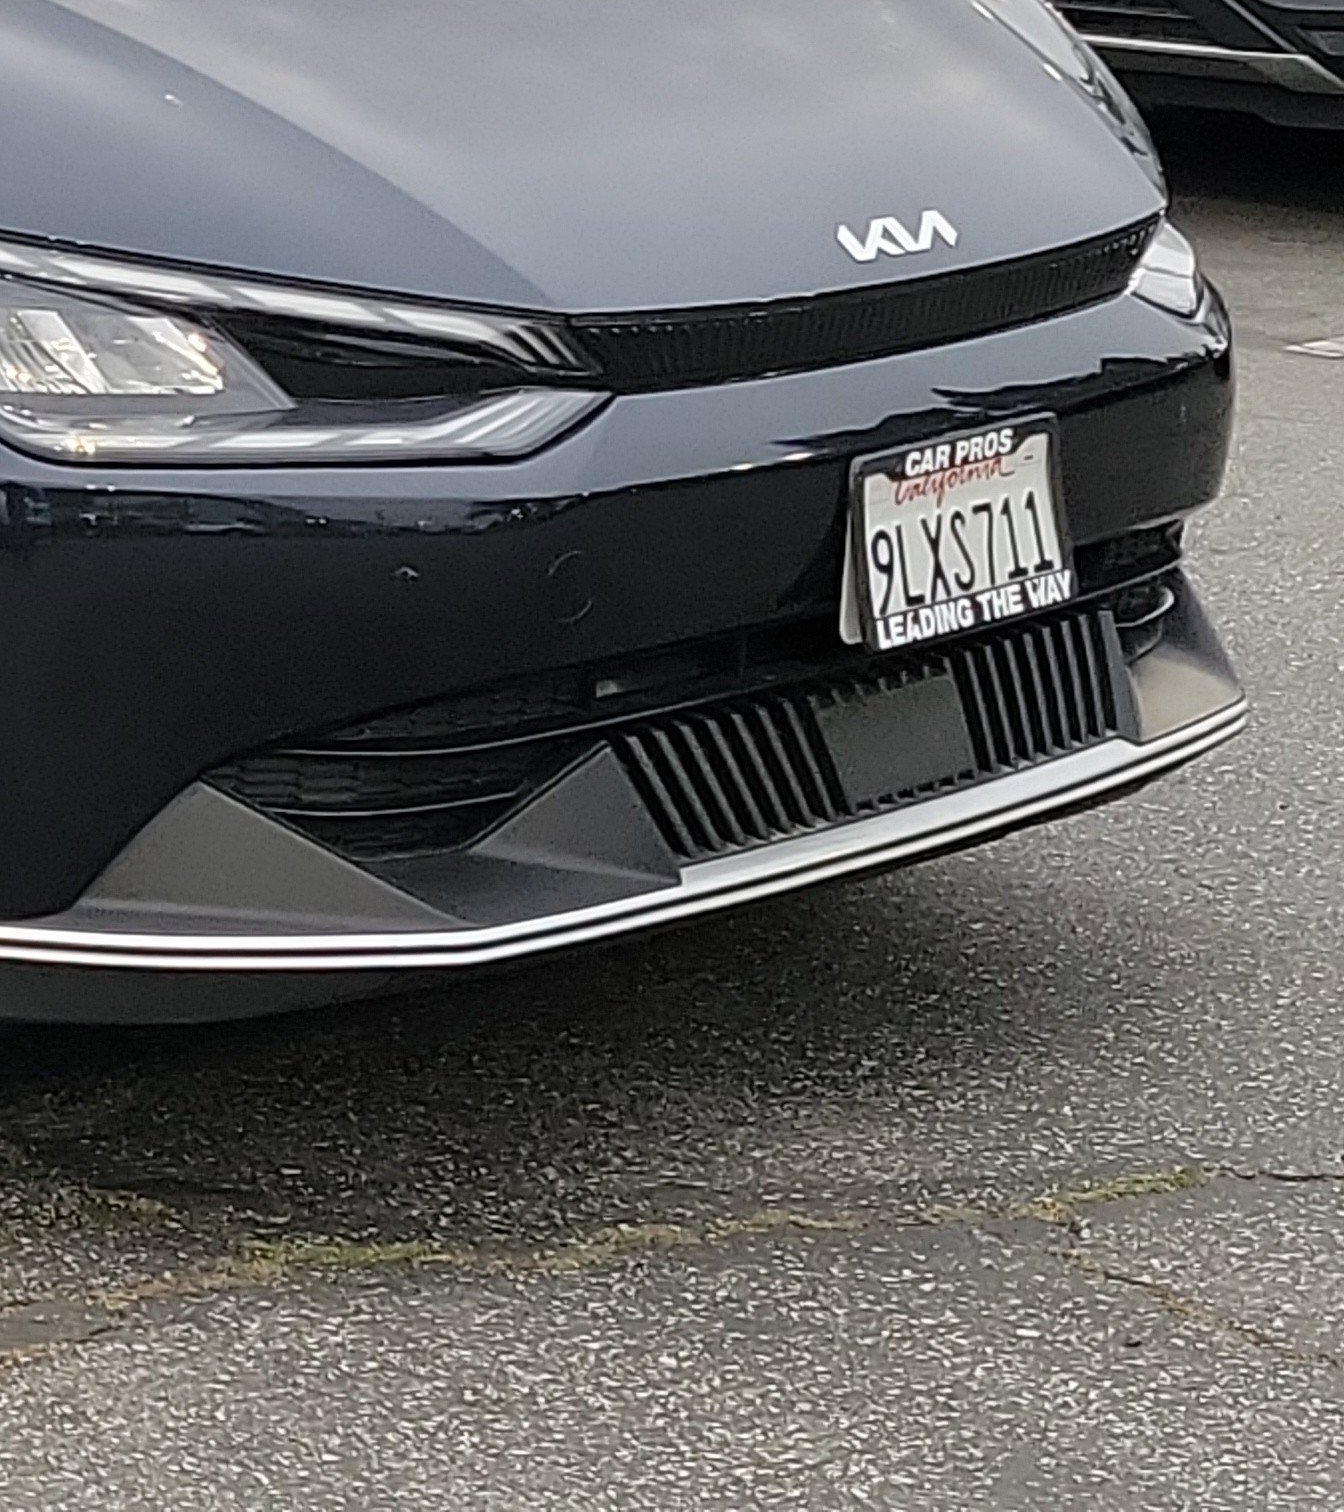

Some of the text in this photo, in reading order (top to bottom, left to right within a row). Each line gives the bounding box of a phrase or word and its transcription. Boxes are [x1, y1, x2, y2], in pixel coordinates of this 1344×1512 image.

[836, 209, 959, 262] KIA
[905, 427, 1015, 477] CAR PROS
[870, 489, 1055, 617] 9LXS711
[876, 568, 1072, 651] LEADING THE WAY
